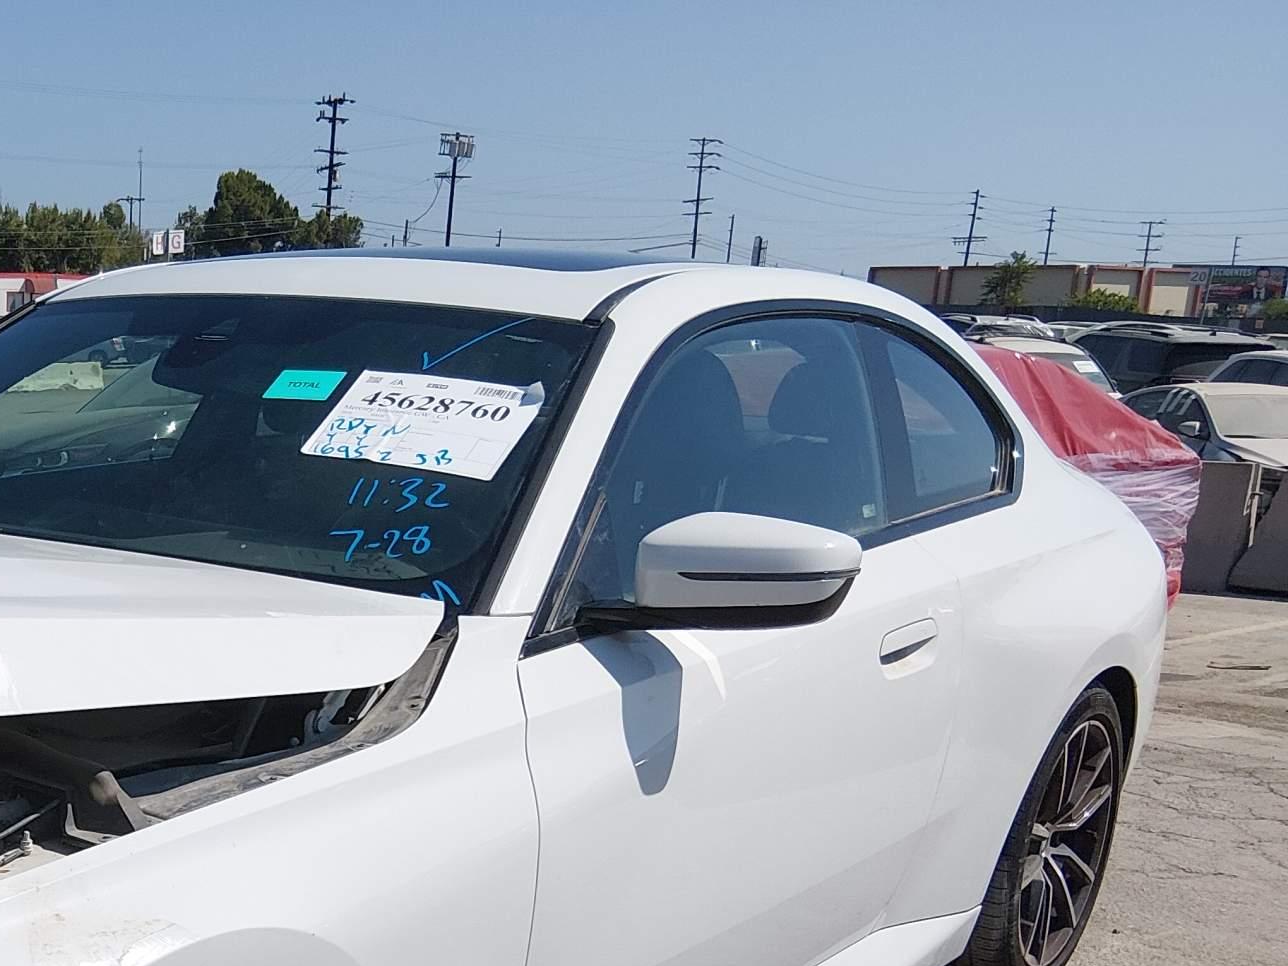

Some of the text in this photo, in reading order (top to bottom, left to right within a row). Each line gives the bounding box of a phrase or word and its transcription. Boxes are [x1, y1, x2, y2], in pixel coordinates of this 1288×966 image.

[1192, 271, 1207, 282] 20
[288, 381, 321, 389] TOTAL
[361, 391, 511, 422] 45628760
[348, 477, 450, 512] 11:32
[329, 525, 431, 561] 7-28
